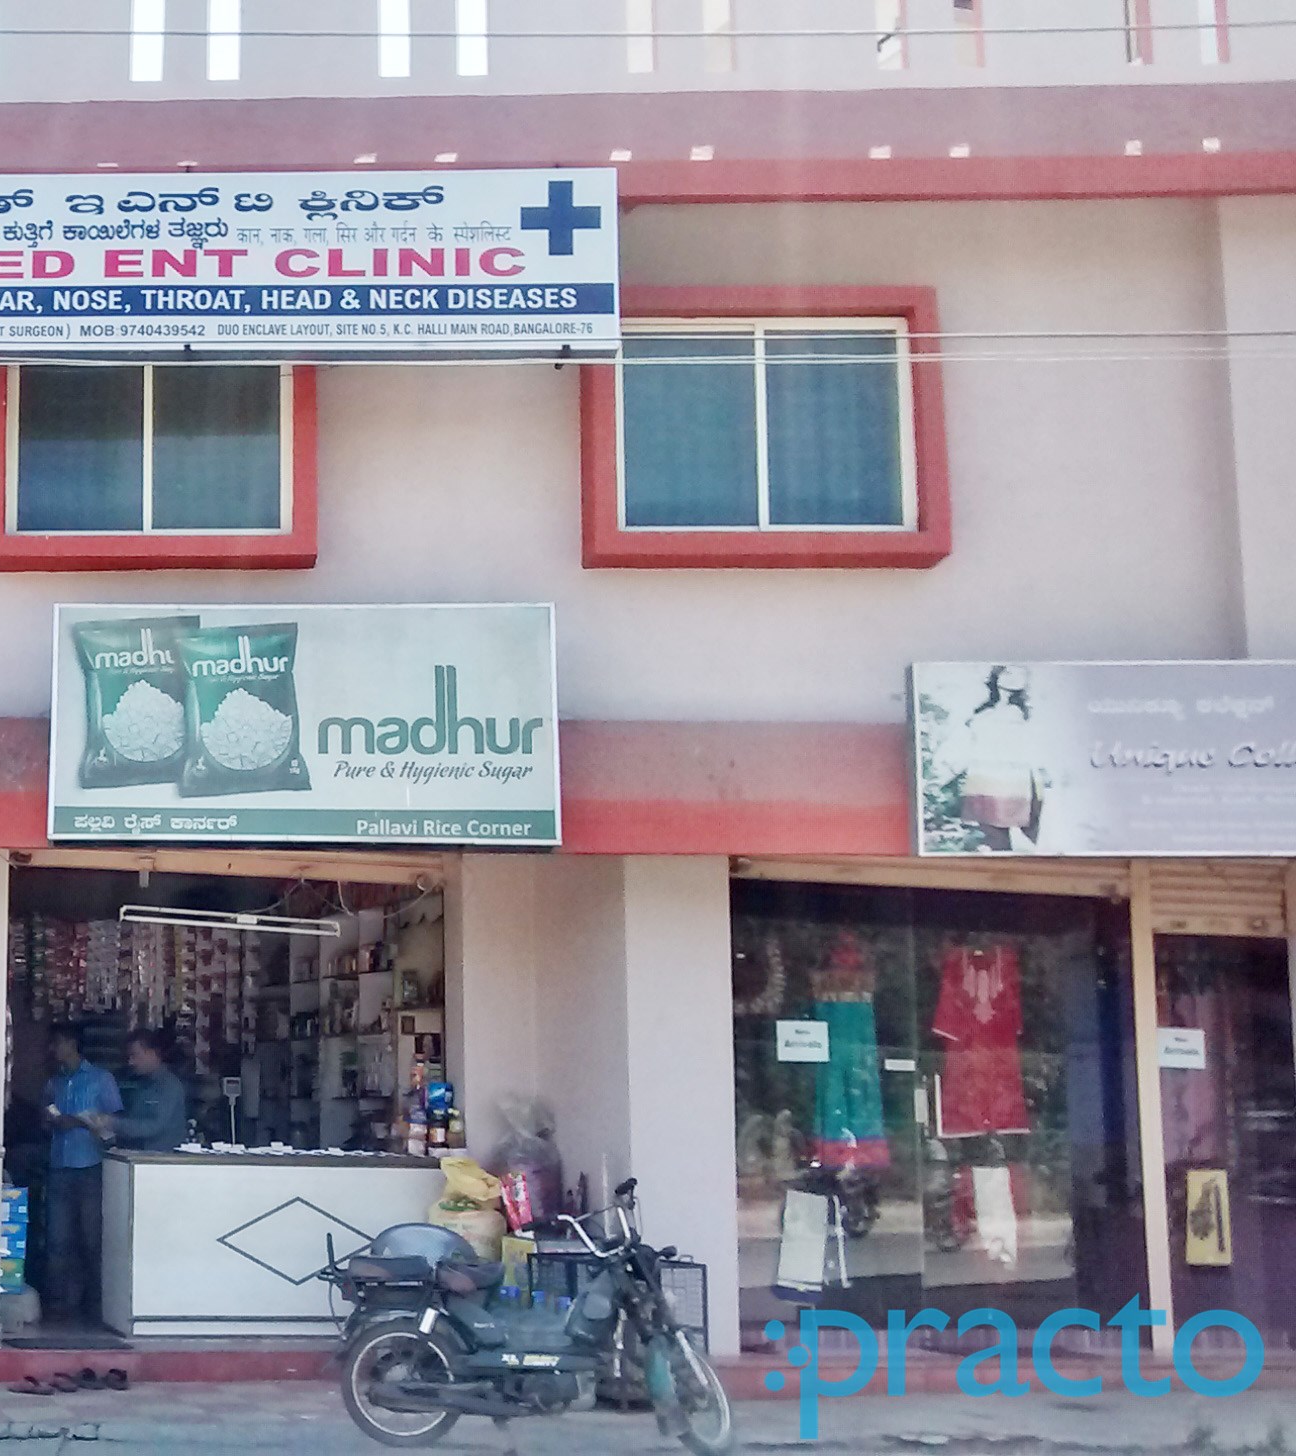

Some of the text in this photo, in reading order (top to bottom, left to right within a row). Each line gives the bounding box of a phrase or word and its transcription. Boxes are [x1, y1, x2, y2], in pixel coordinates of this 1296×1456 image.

[65, 194, 105, 215] ಇ
[117, 187, 220, 213] ಎನ್
[234, 192, 274, 212] ಟಿ
[297, 185, 444, 221] ಕ್ಲಿನಿಕ್
[3, 219, 53, 248] ಕುತ್ತಿಗೆ
[62, 218, 160, 241] ಕಾಯಿಲೆಗಳ
[335, 221, 358, 243] सिर
[364, 220, 386, 243] और
[390, 220, 418, 243] गर्दन
[426, 222, 444, 243] के
[104, 248, 249, 278] ENT
[275, 247, 526, 278] CLINIC
[53, 290, 132, 314] NOSE,
[140, 289, 252, 313] THROAT,
[261, 289, 332, 310] HEAD
[339, 288, 362, 310] &
[369, 288, 440, 310] NECK
[447, 287, 578, 309] DISEASES
[217, 323, 240, 336] DUO
[242, 323, 287, 336] ENCLAVE
[290, 323, 333, 338] LAYOUT,
[336, 323, 359, 336] SITE
[417, 322, 447, 336] HALLI
[450, 322, 478, 335] MAIN
[94, 627, 176, 669] madhu
[191, 635, 289, 677] madhur
[317, 664, 544, 755] madhur
[333, 760, 534, 785] Pure & Hygienic Sugar
[73, 814, 116, 832] ಪಲ್ಲವಿ
[356, 818, 532, 837] Pallavi Rice Corner
